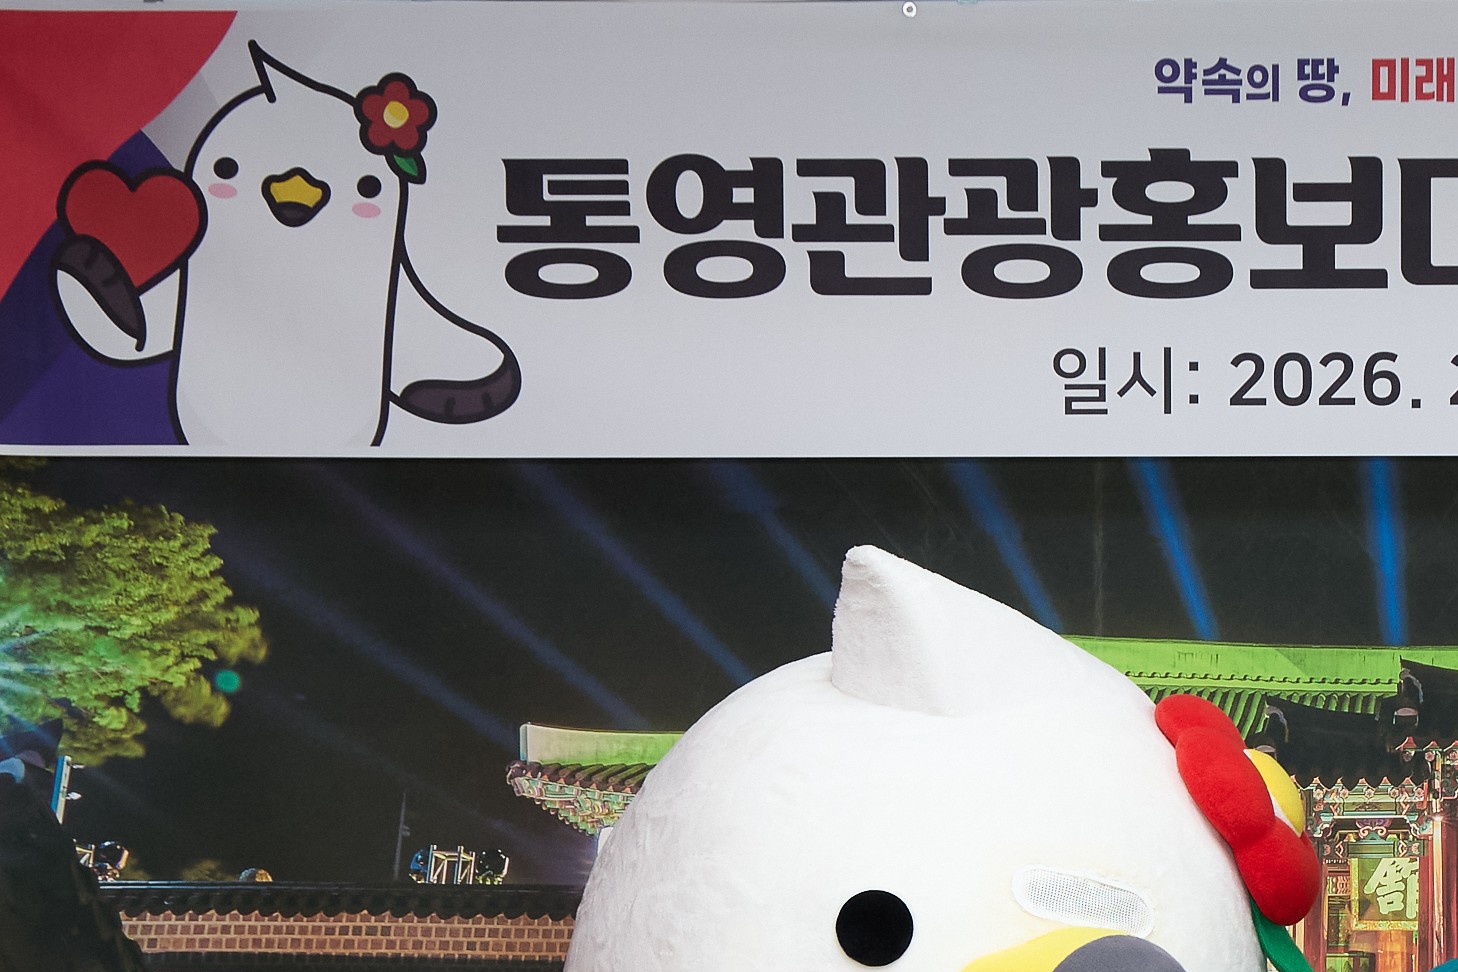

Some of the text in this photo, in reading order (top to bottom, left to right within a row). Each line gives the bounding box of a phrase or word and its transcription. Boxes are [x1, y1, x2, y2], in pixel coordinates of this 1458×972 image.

[1154, 57, 1280, 104] 약속의
[1296, 57, 1351, 107] 땅,
[1371, 57, 1456, 103] 미래
[1052, 346, 1199, 416] 일시:
[1229, 351, 1422, 409] 2026.
